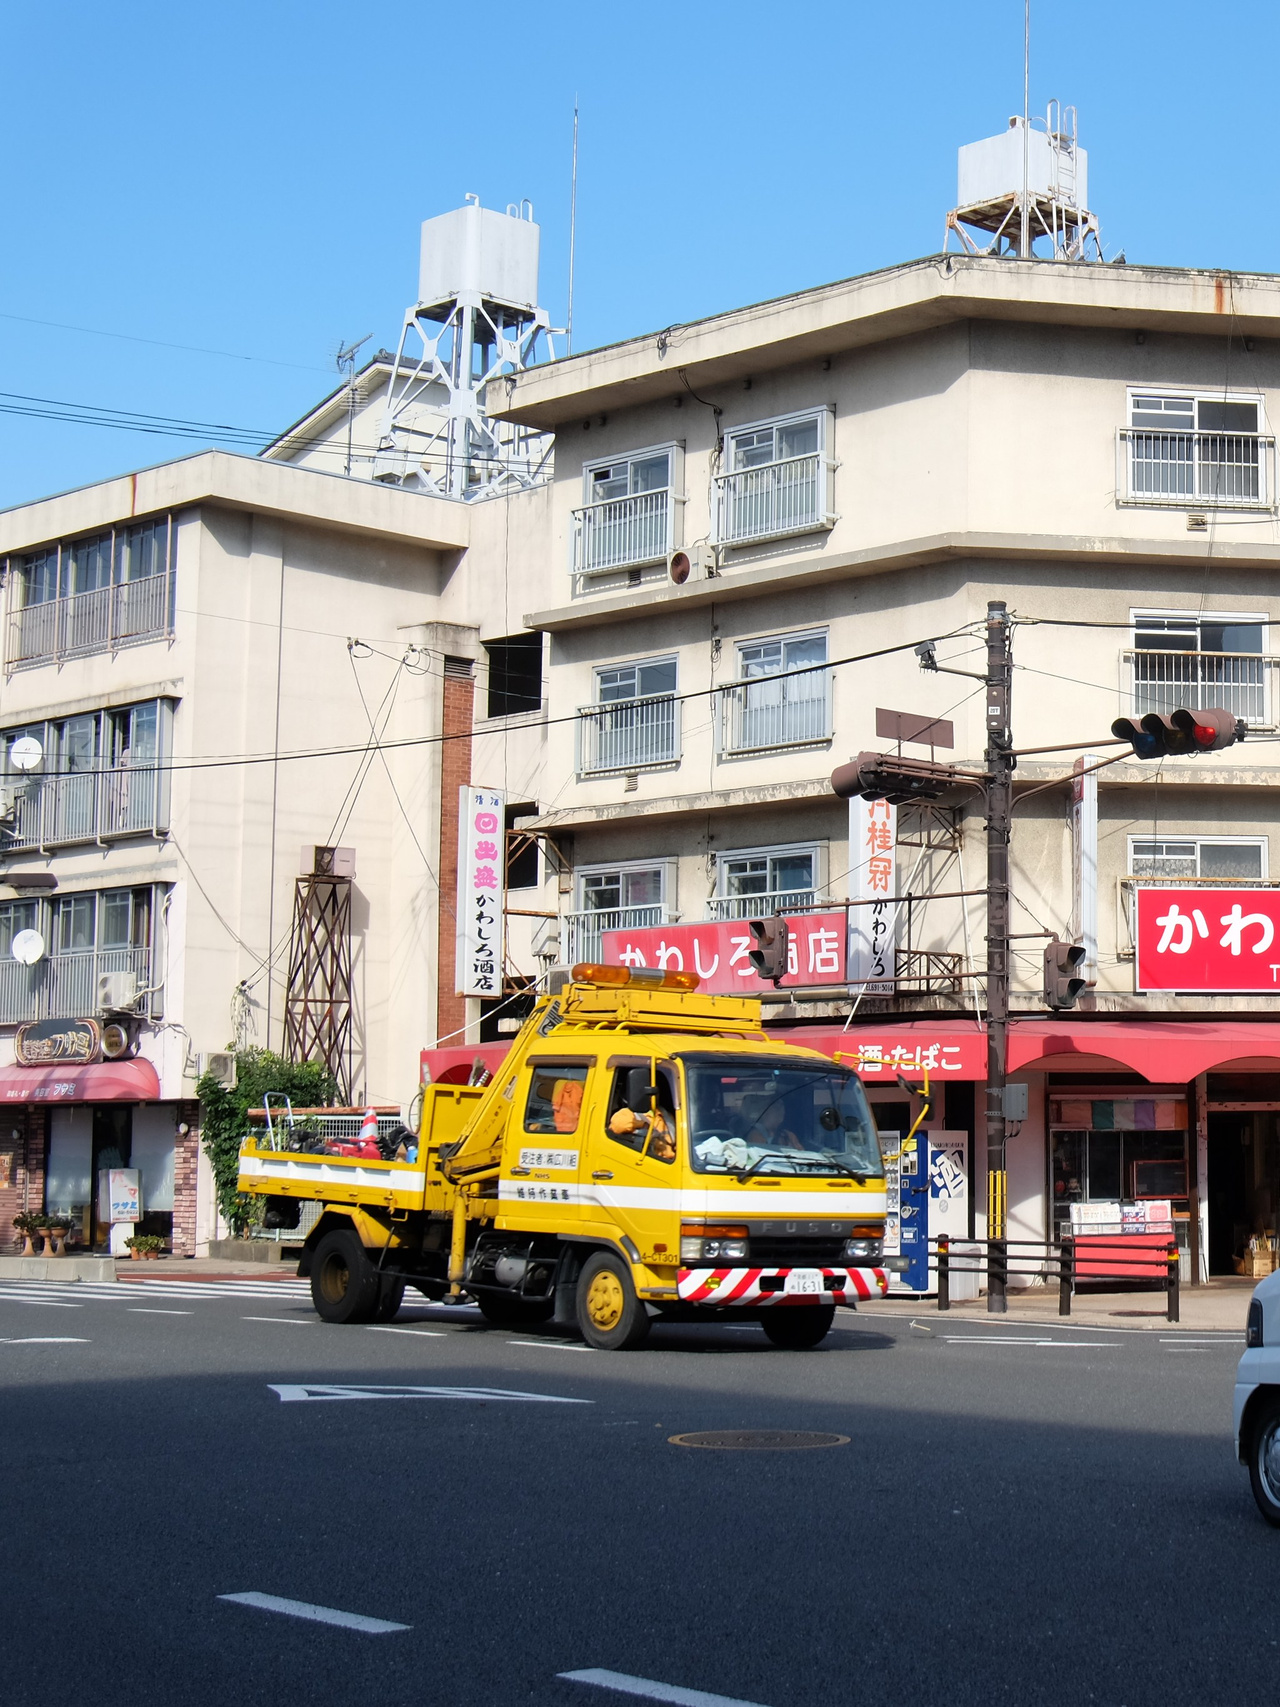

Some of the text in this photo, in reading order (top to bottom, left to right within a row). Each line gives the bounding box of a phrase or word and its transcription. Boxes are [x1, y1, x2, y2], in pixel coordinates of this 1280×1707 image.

[473, 894, 495, 990] かわしろ酒店
[762, 1222, 842, 1233] FUSO
[797, 1281, 821, 1293] 16-31
